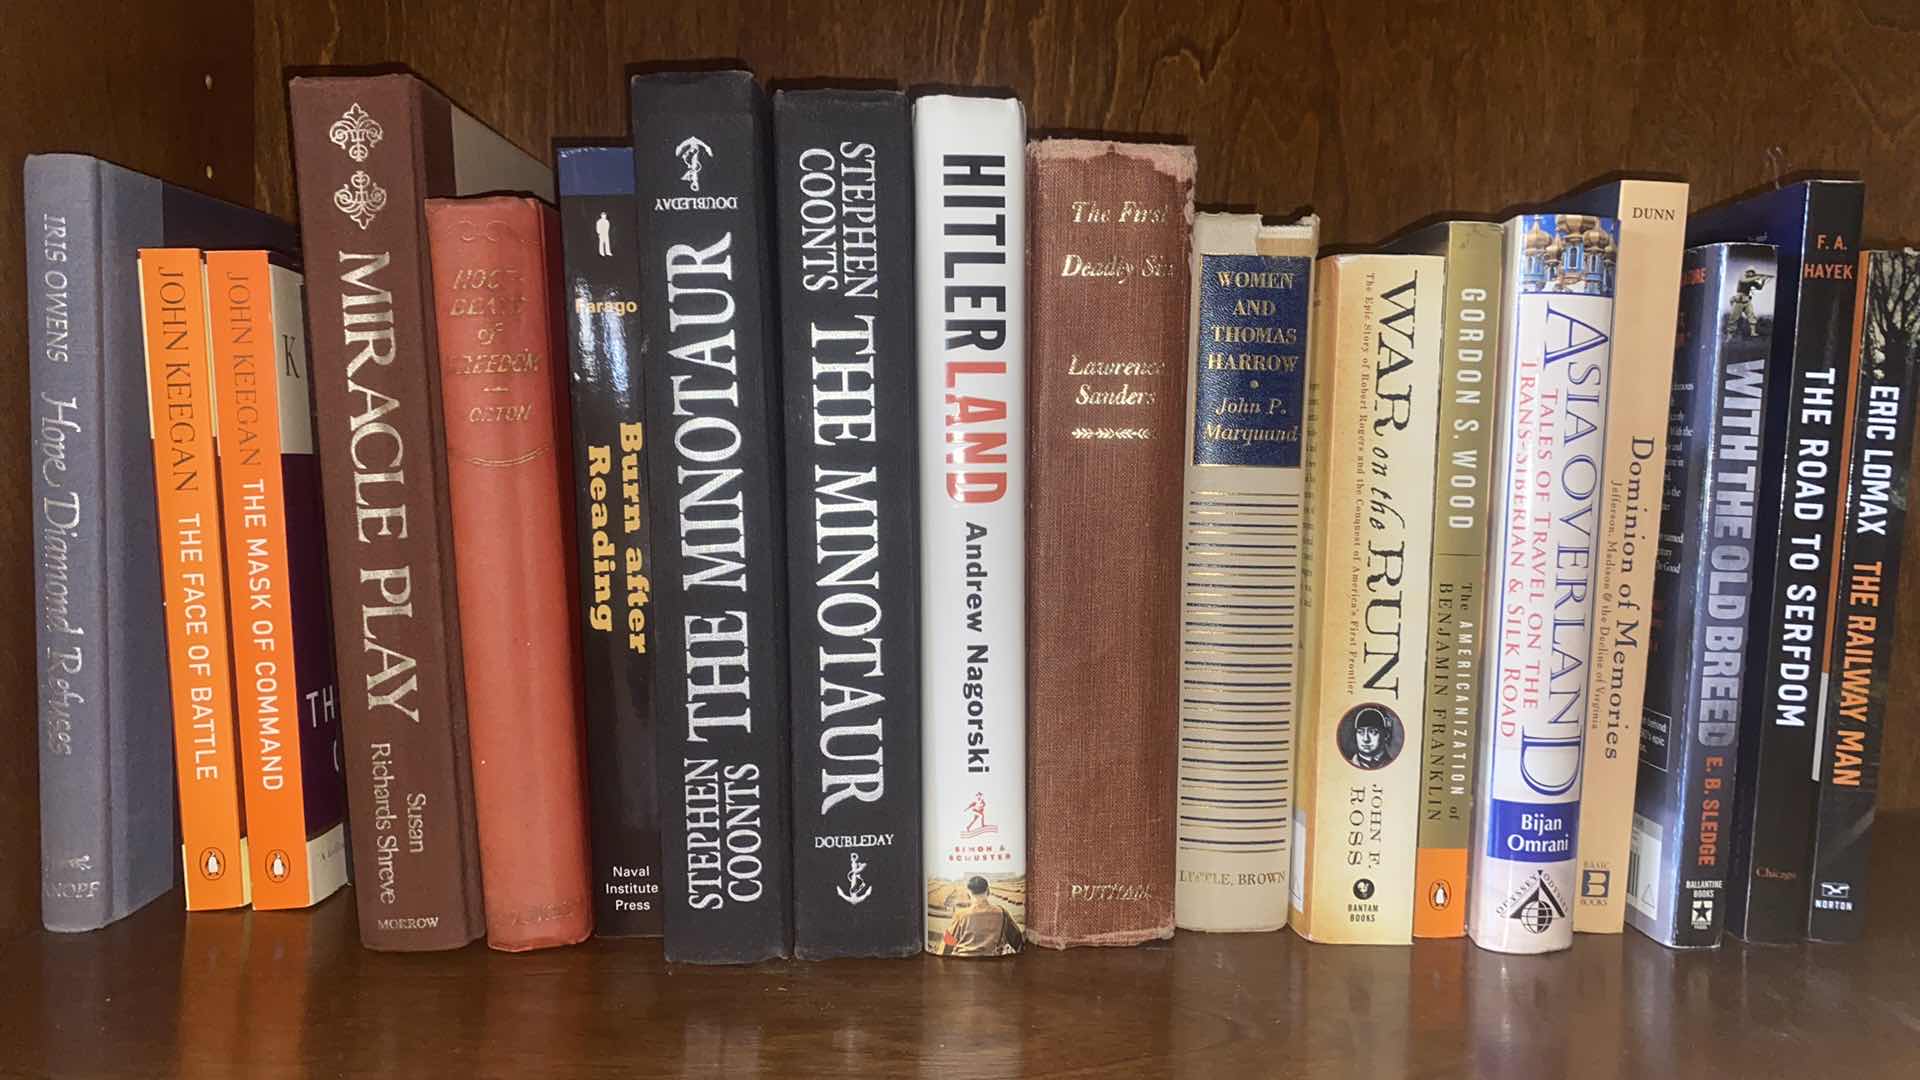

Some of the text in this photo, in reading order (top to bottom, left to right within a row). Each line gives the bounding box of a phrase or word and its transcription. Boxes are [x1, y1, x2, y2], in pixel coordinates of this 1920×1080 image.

[654, 197, 739, 211] DOUBLEDAY
[799, 148, 838, 291] COONTS
[840, 142, 878, 299] STEPHEN
[1072, 200, 1169, 224] The First
[1632, 206, 1675, 221] DUNN
[1816, 234, 1848, 251] F. A.
[43, 213, 69, 363] IRIS OWENS
[1061, 254, 1135, 284] Deadly
[1216, 271, 1296, 288] WOMEN
[1366, 273, 1376, 292] The
[1803, 263, 1853, 280] HAYEK
[943, 154, 1008, 503] HITLERLAND
[1233, 300, 1277, 317] AND
[282, 334, 301, 378] K
[1211, 325, 1298, 344] THOMAS
[159, 265, 200, 492] JOHN KEEGAN
[227, 271, 261, 467] JOHN KEEGAN
[1068, 354, 1166, 375] Lawrence
[1207, 353, 1299, 372] HARROW
[1361, 357, 1371, 368] of
[1075, 384, 1157, 405] Sanders
[1215, 397, 1287, 416] John P.
[1448, 288, 1487, 528] GORDON S. WOOD
[1203, 423, 1298, 445] Marquand
[1356, 455, 1366, 475] and
[1856, 384, 1900, 536] ERIC LOMAX
[338, 250, 420, 722] MIRACLE PLAY
[666, 231, 751, 743] THE MINOTAUR
[1355, 478, 1365, 496] the
[1362, 269, 1418, 700] WAR on the RUN
[587, 445, 616, 633] Reading
[619, 422, 650, 655] Burn after
[1351, 499, 1364, 546] Conquest
[811, 314, 886, 816] THE MINOTAUR
[1352, 550, 1362, 562] of
[1520, 300, 1609, 796] ASIA OVERLAND
[1522, 386, 1559, 709] TALES OF TRAVEL ON THE
[1698, 358, 1766, 747] WITH THE OLD BREED
[1775, 367, 1836, 727] THE ROAD TO SERFDOM
[1508, 577, 1524, 593] &
[1604, 435, 1655, 760] Dominion of Memories
[178, 512, 219, 781] THE FACE OF BATTLE
[242, 479, 285, 791] THE MASK OF COMMAND
[963, 521, 990, 773] Andrew Nagorski
[1349, 620, 1359, 647] First
[1504, 602, 1524, 656] SILK
[1832, 561, 1883, 786] THE RAILWAY MAN
[1428, 582, 1454, 821] BENJAMIN FRANKLIN
[1449, 582, 1473, 820] The AMERICANIZATION of
[1500, 667, 1521, 738] ROAD
[371, 742, 401, 905] Richards Shreve
[406, 793, 427, 853] Susan
[724, 763, 763, 902] COONTS
[1347, 787, 1366, 866] ROSS
[1368, 783, 1384, 869] JOHN F.
[1521, 813, 1562, 836] Bijan
[1698, 755, 1724, 866] E. B. SLEDGE
[683, 758, 724, 910] STEPHEN
[814, 833, 894, 848] DOUBLEDAY
[1507, 834, 1569, 852] Omrani
[605, 882, 659, 895] Institute
[612, 866, 650, 878] Naval
[1178, 869, 1287, 887] LITTLE, BROWN
[1685, 880, 1723, 889] BALLANTINE
[1755, 867, 1797, 881] Chicago
[377, 916, 439, 930] MORROW
[615, 899, 651, 911] Press
[1347, 903, 1379, 913] BANTAM
[1349, 913, 1376, 923] BOOKS
[1814, 899, 1853, 911] NORTON
